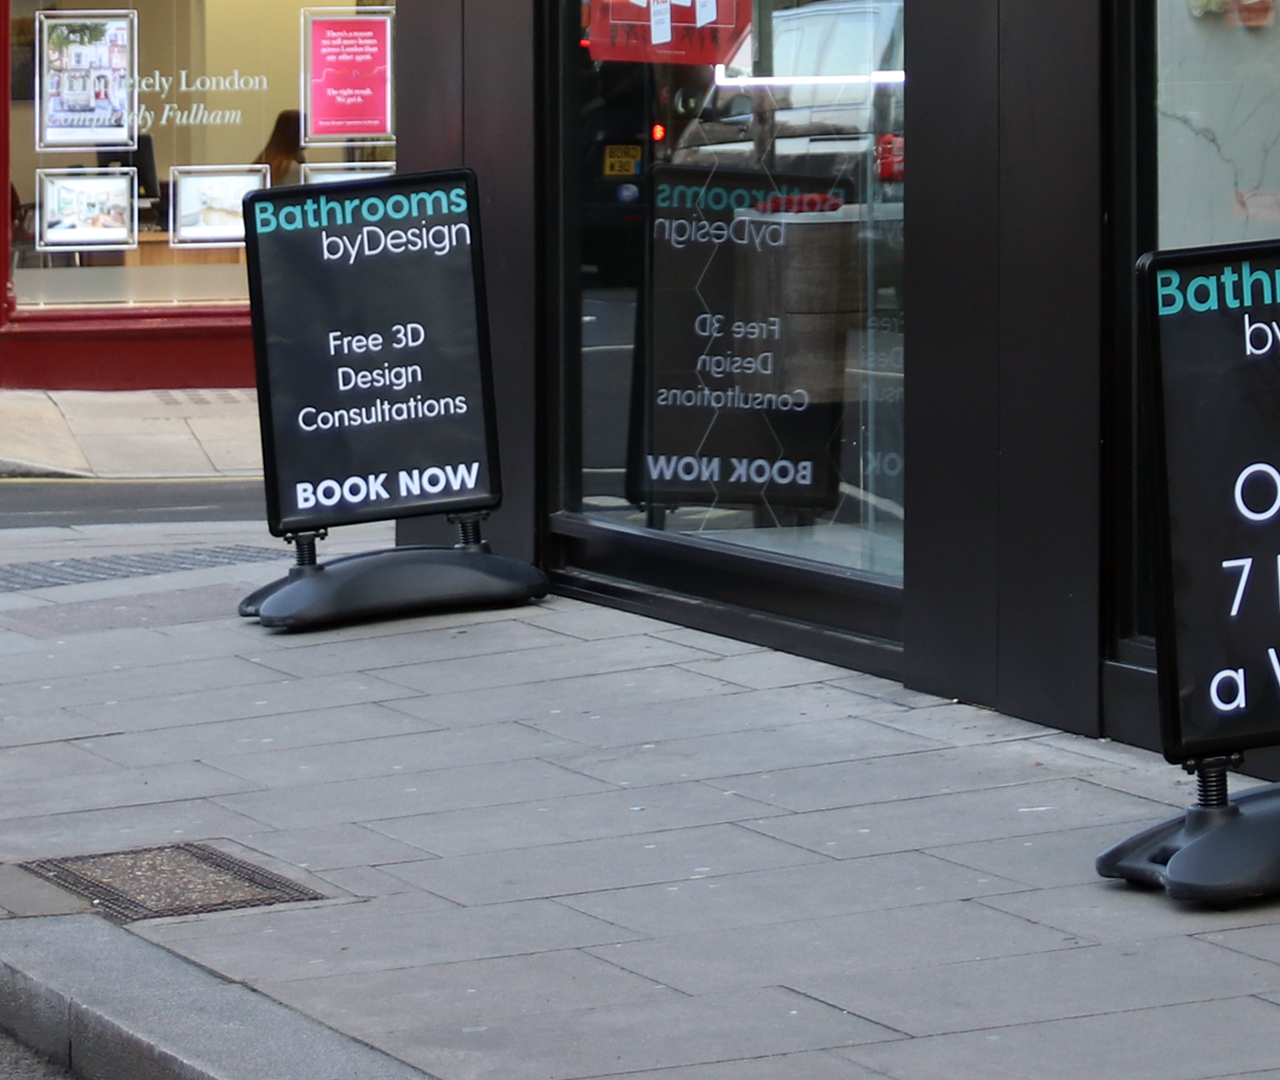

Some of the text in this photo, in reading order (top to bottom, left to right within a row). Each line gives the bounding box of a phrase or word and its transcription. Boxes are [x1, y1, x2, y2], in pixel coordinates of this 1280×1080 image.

[179, 69, 269, 91] London
[159, 103, 243, 126] Fulham
[255, 186, 468, 234] Bathrooms
[321, 219, 471, 265] byDesign
[328, 323, 425, 356] Free 3D
[338, 362, 422, 391] Design
[298, 393, 468, 432] Consultations
[295, 462, 480, 510] BOOK NOW
[1222, 557, 1254, 616] 7
[1209, 667, 1247, 711] a
